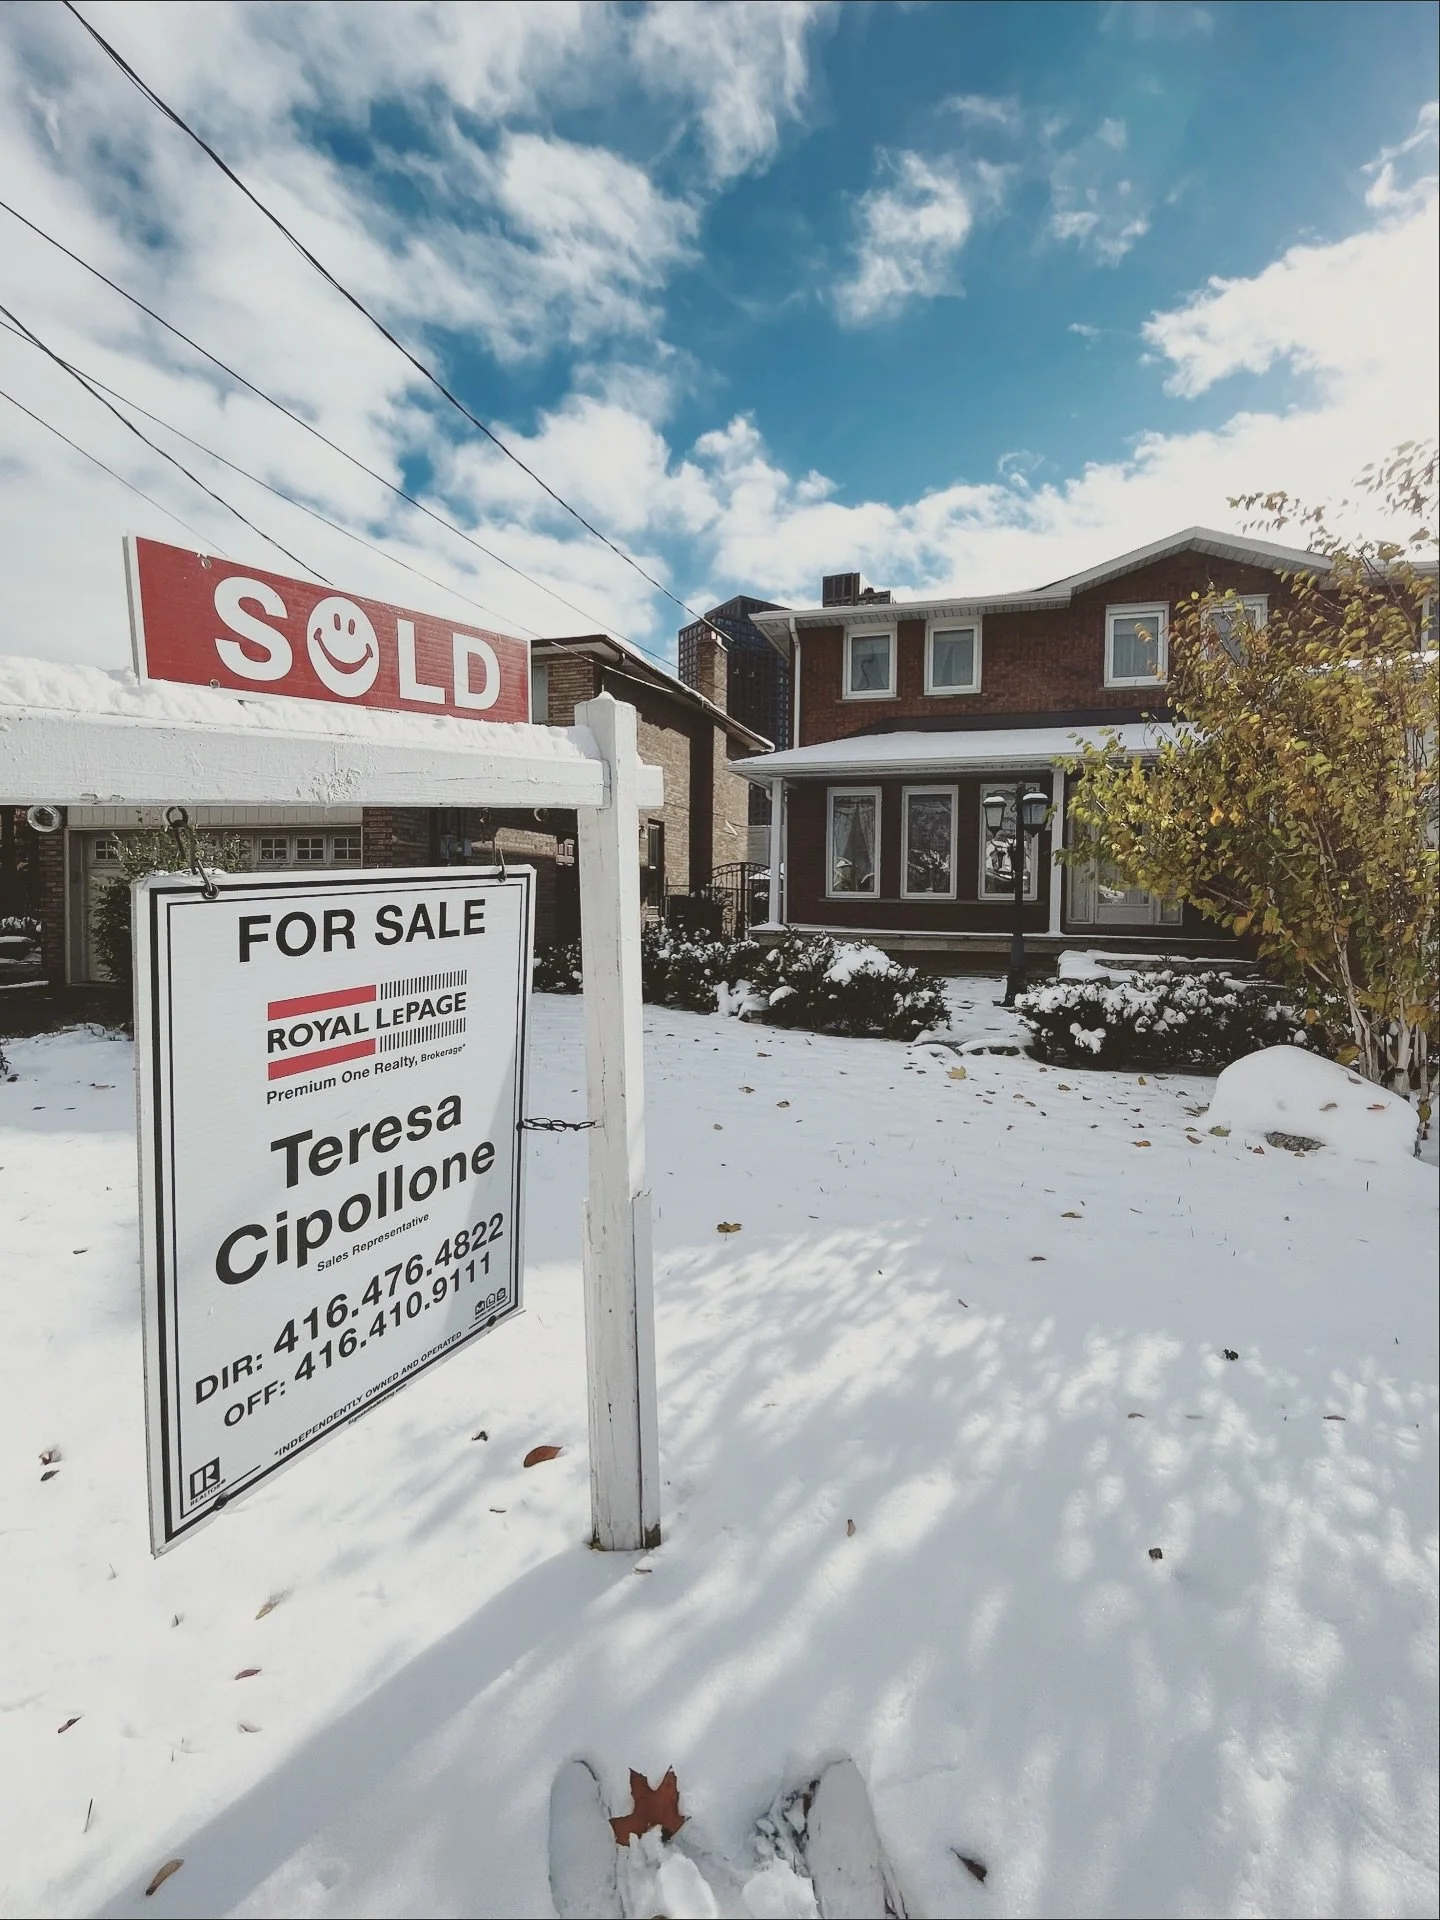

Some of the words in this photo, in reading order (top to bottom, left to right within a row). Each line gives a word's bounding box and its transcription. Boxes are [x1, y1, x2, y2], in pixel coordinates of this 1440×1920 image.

[238, 908, 355, 963] FOR
[375, 898, 485, 946] SALE
[267, 1012, 369, 1054] ROYAL
[266, 1076, 337, 1105] Premium
[341, 1066, 370, 1084] One
[374, 1054, 418, 1075] Realty,
[270, 1094, 462, 1189] Teresa
[215, 1141, 495, 1285] Cipollone
[317, 1252, 349, 1272] Sales
[352, 1212, 430, 1255] Representative
[195, 1353, 263, 1405] DIR:
[273, 1212, 504, 1354] 416.476.4822
[224, 1380, 286, 1427] OFF:
[294, 1251, 492, 1382] 416.410.9111
[365, 1370, 400, 1398] OWNED
[401, 1359, 419, 1376] AND
[421, 1331, 462, 1362] OPERATED
